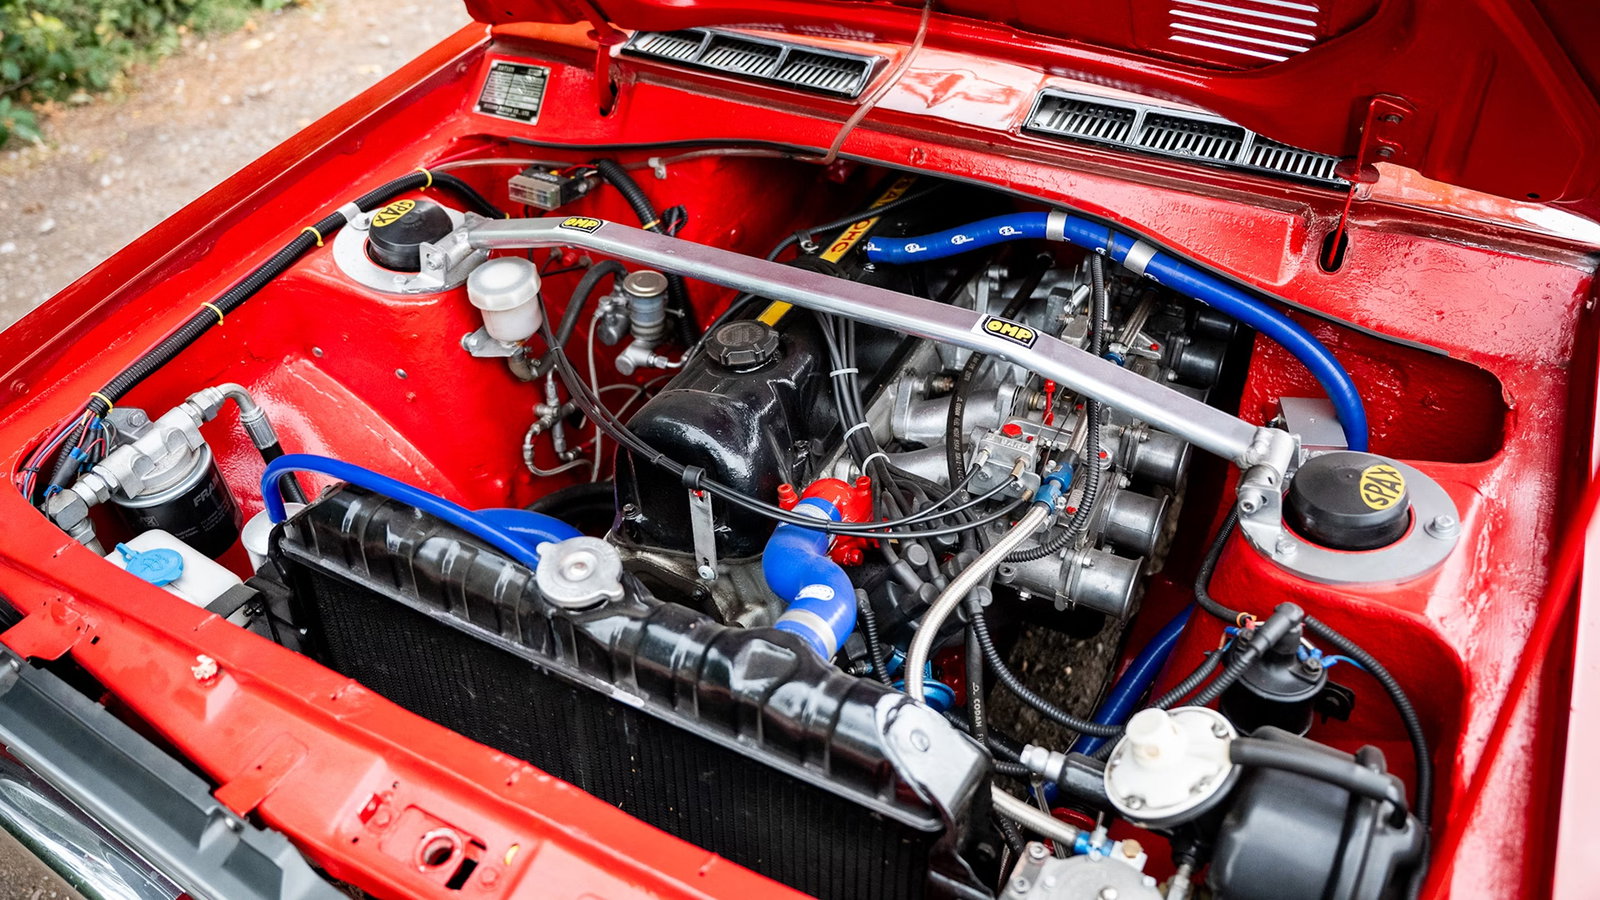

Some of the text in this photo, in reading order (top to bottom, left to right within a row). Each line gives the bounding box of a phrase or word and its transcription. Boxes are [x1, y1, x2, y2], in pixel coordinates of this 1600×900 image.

[563, 217, 599, 228] OMP
[986, 320, 1033, 340] OMP
[1363, 467, 1402, 506] SPAX
[974, 698, 982, 727] CODAN
